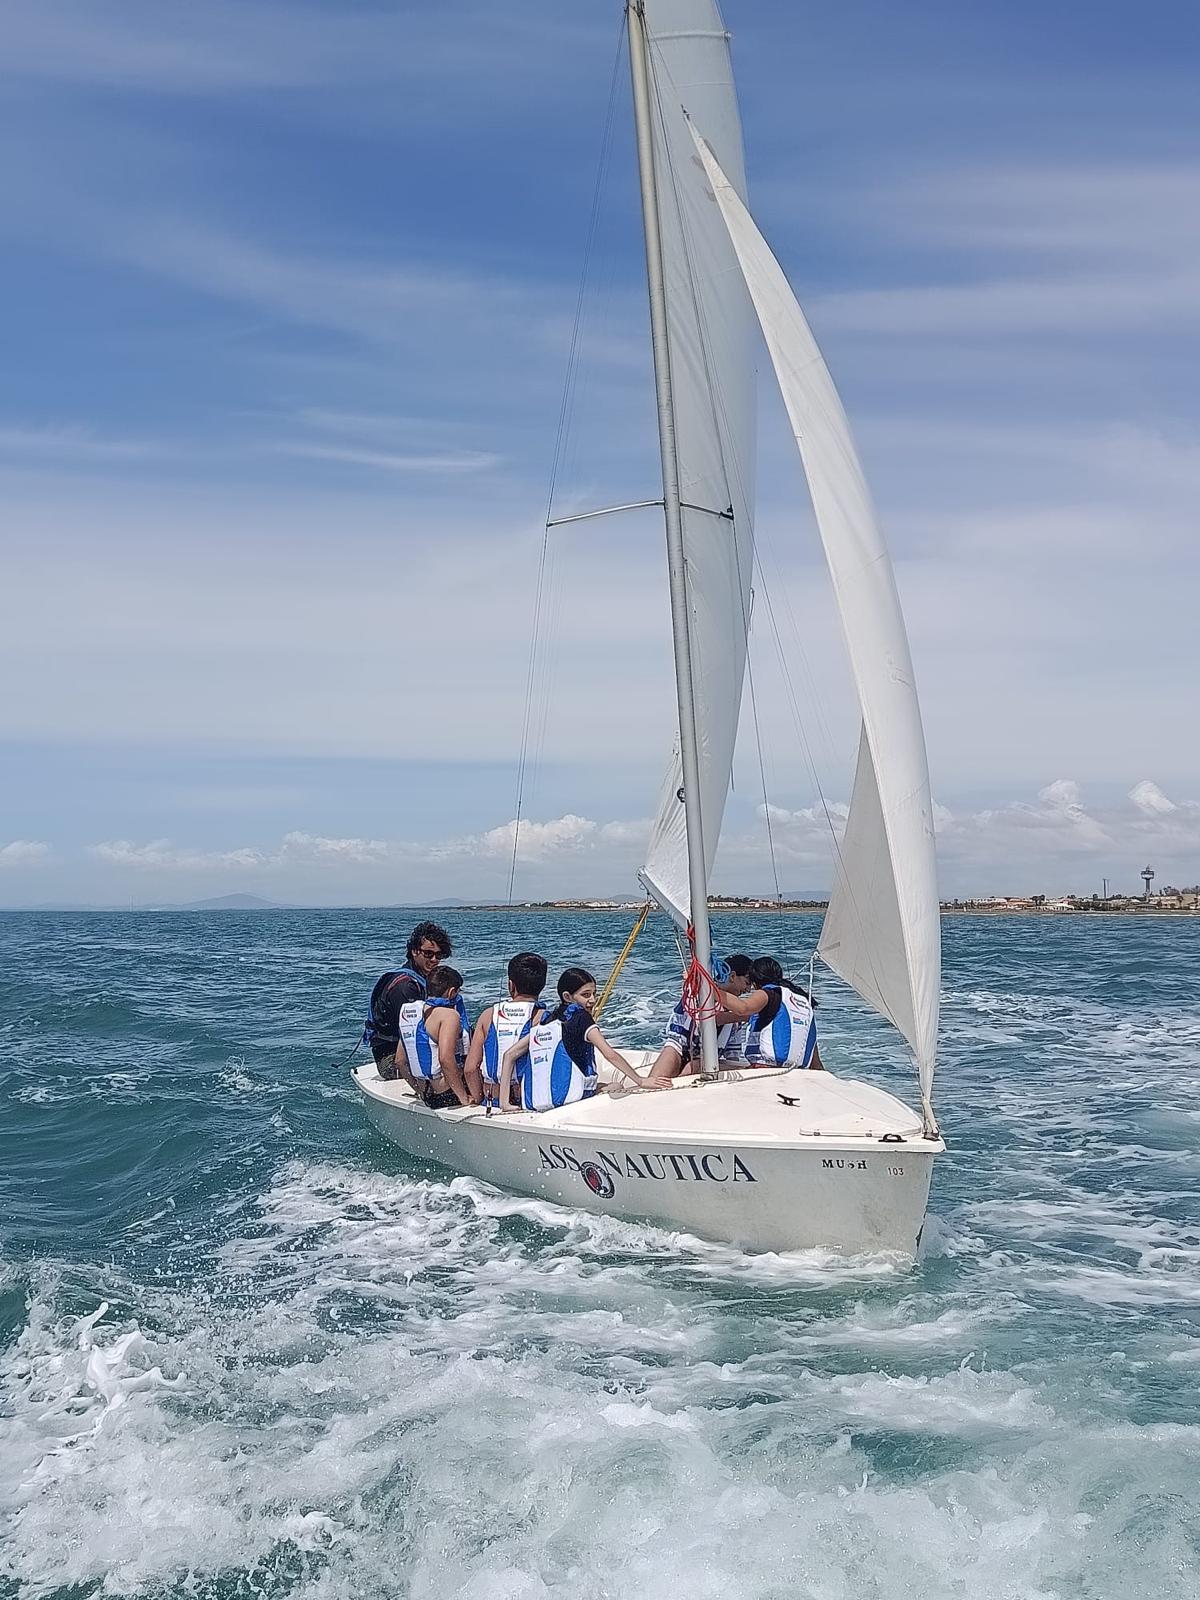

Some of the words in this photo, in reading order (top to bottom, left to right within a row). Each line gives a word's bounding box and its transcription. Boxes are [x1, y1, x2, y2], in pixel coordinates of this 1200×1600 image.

[595, 1151, 759, 1182] NAUTICA
[821, 1159, 868, 1170] MUSH
[887, 1167, 905, 1176] 103
